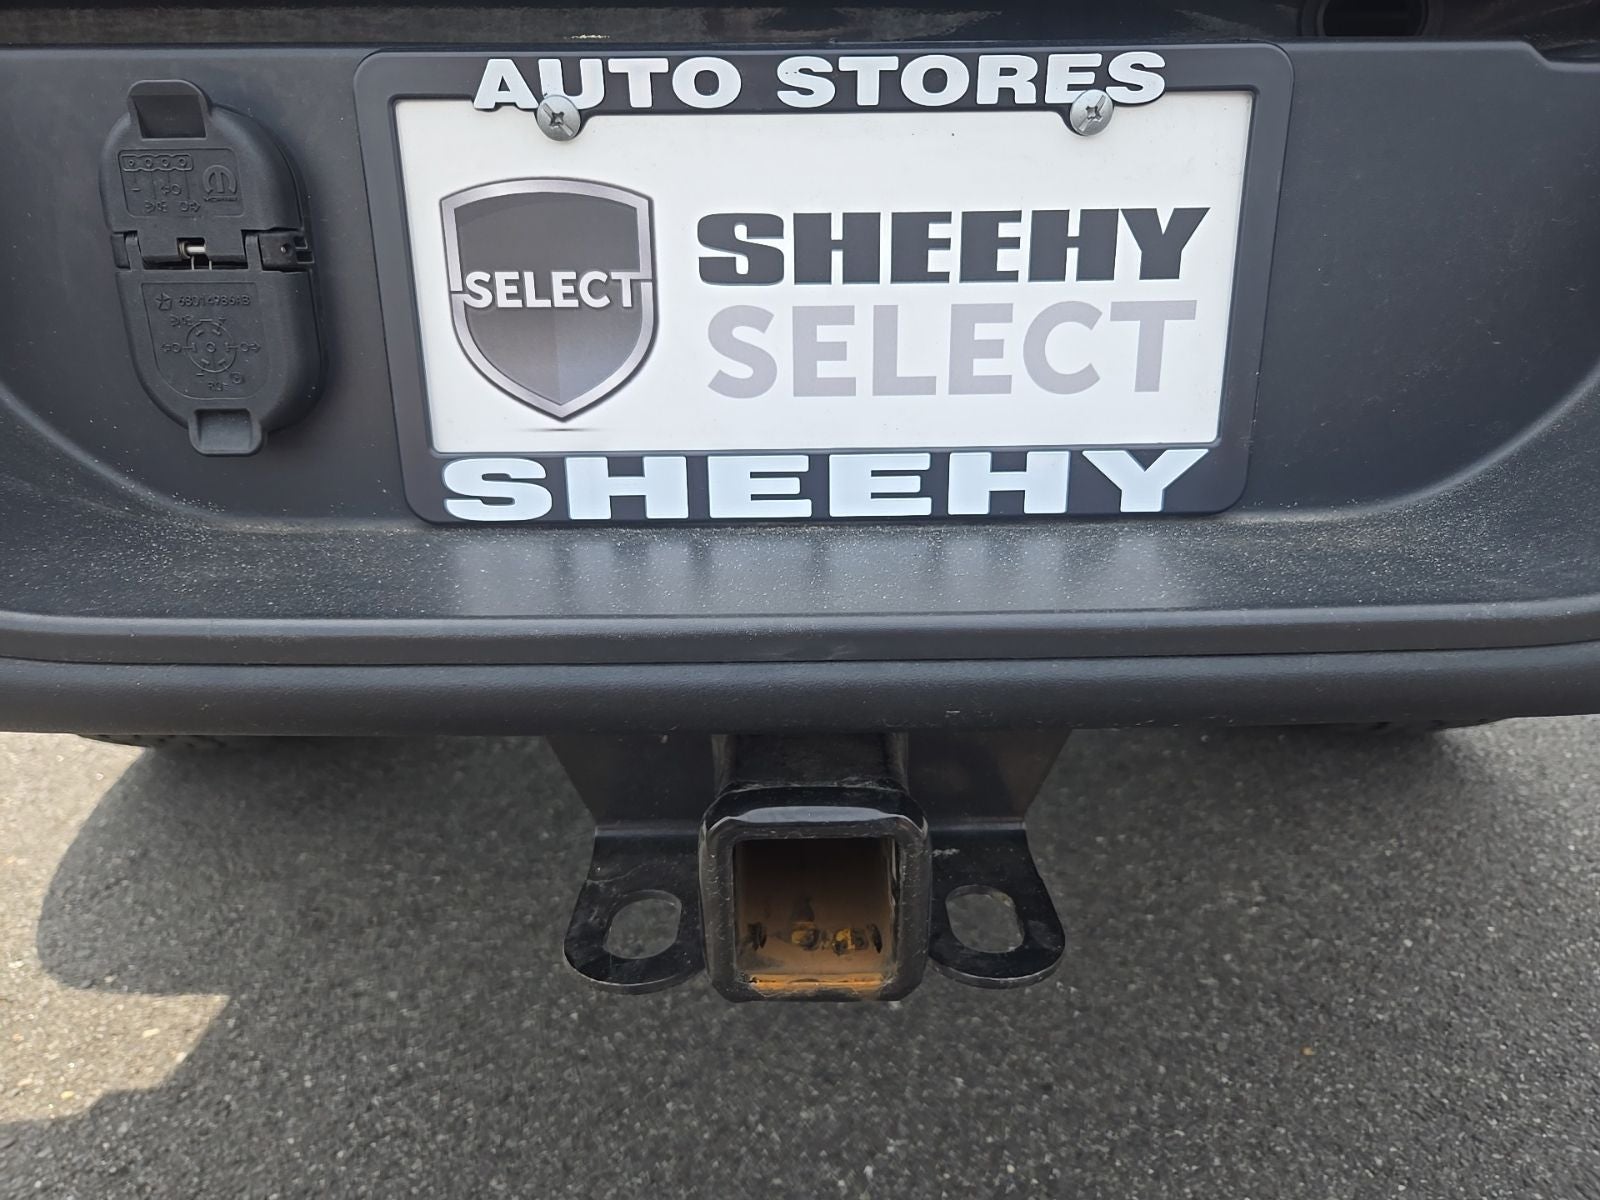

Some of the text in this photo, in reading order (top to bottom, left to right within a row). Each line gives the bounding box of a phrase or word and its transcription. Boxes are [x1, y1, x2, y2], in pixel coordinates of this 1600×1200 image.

[473, 51, 1166, 111] AUTO STORES
[697, 206, 1210, 286] SHEEHY
[462, 268, 638, 310] SELECT
[707, 298, 1198, 398] SELECT
[442, 448, 1210, 522] SHEEHY
